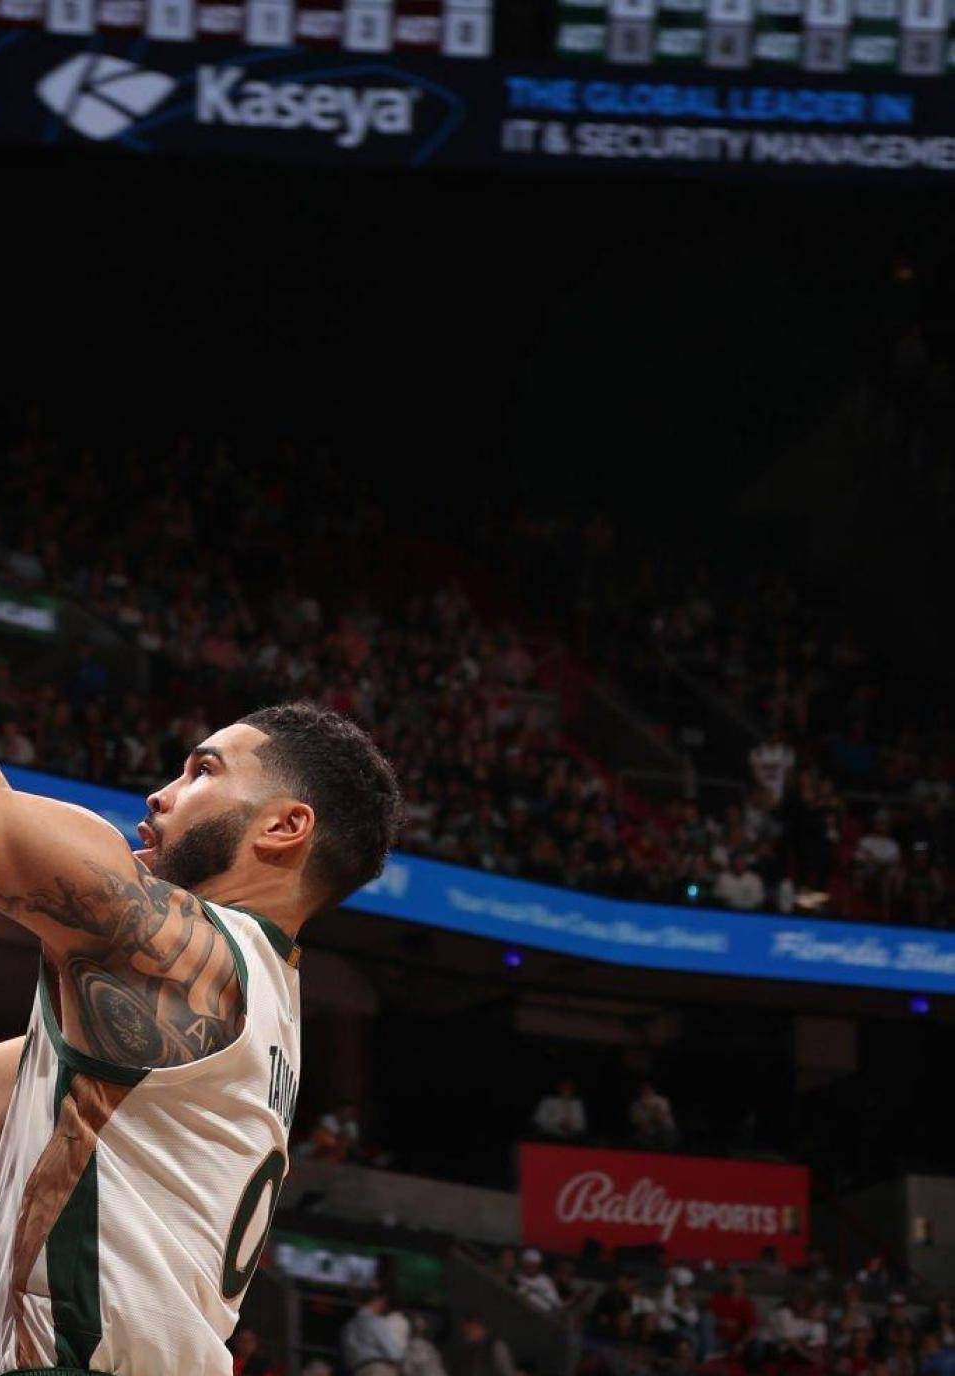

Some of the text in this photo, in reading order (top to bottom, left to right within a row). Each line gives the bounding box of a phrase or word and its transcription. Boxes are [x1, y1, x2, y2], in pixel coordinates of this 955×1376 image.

[196, 64, 415, 148] Kaseya
[574, 123, 744, 162] SECURITY
[555, 1170, 683, 1243] Bally
[683, 1200, 778, 1235] SPORTS
